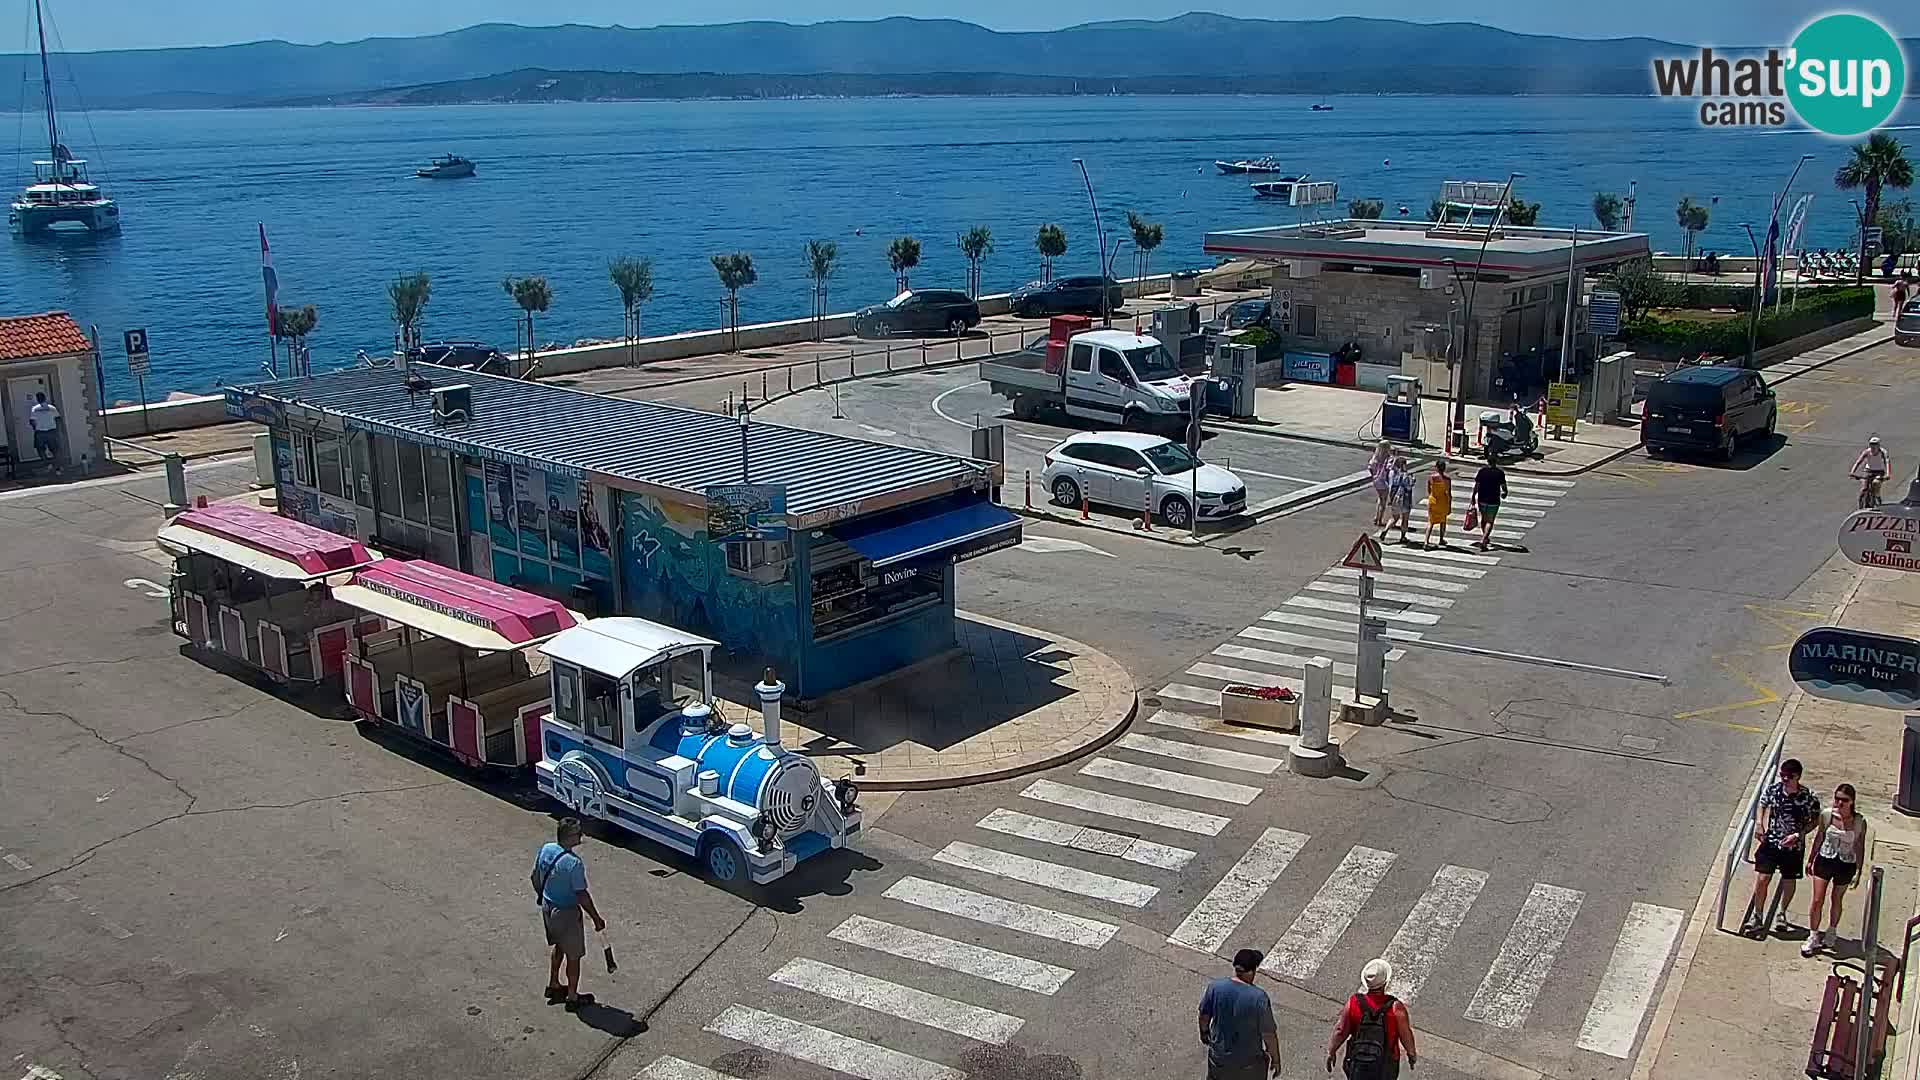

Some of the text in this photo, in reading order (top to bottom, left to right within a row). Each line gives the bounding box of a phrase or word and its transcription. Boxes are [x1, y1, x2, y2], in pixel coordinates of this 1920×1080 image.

[129, 333, 141, 351] P
[479, 447, 493, 459] BUS
[493, 450, 526, 466] STATION
[526, 458, 554, 473] TICKET
[555, 465, 583, 478] OFFICE
[1849, 516, 1920, 534] PIZZE
[465, 612, 492, 629] CENTER
[1802, 643, 1920, 674] MARINER
[1830, 663, 1899, 680] caffe bar
